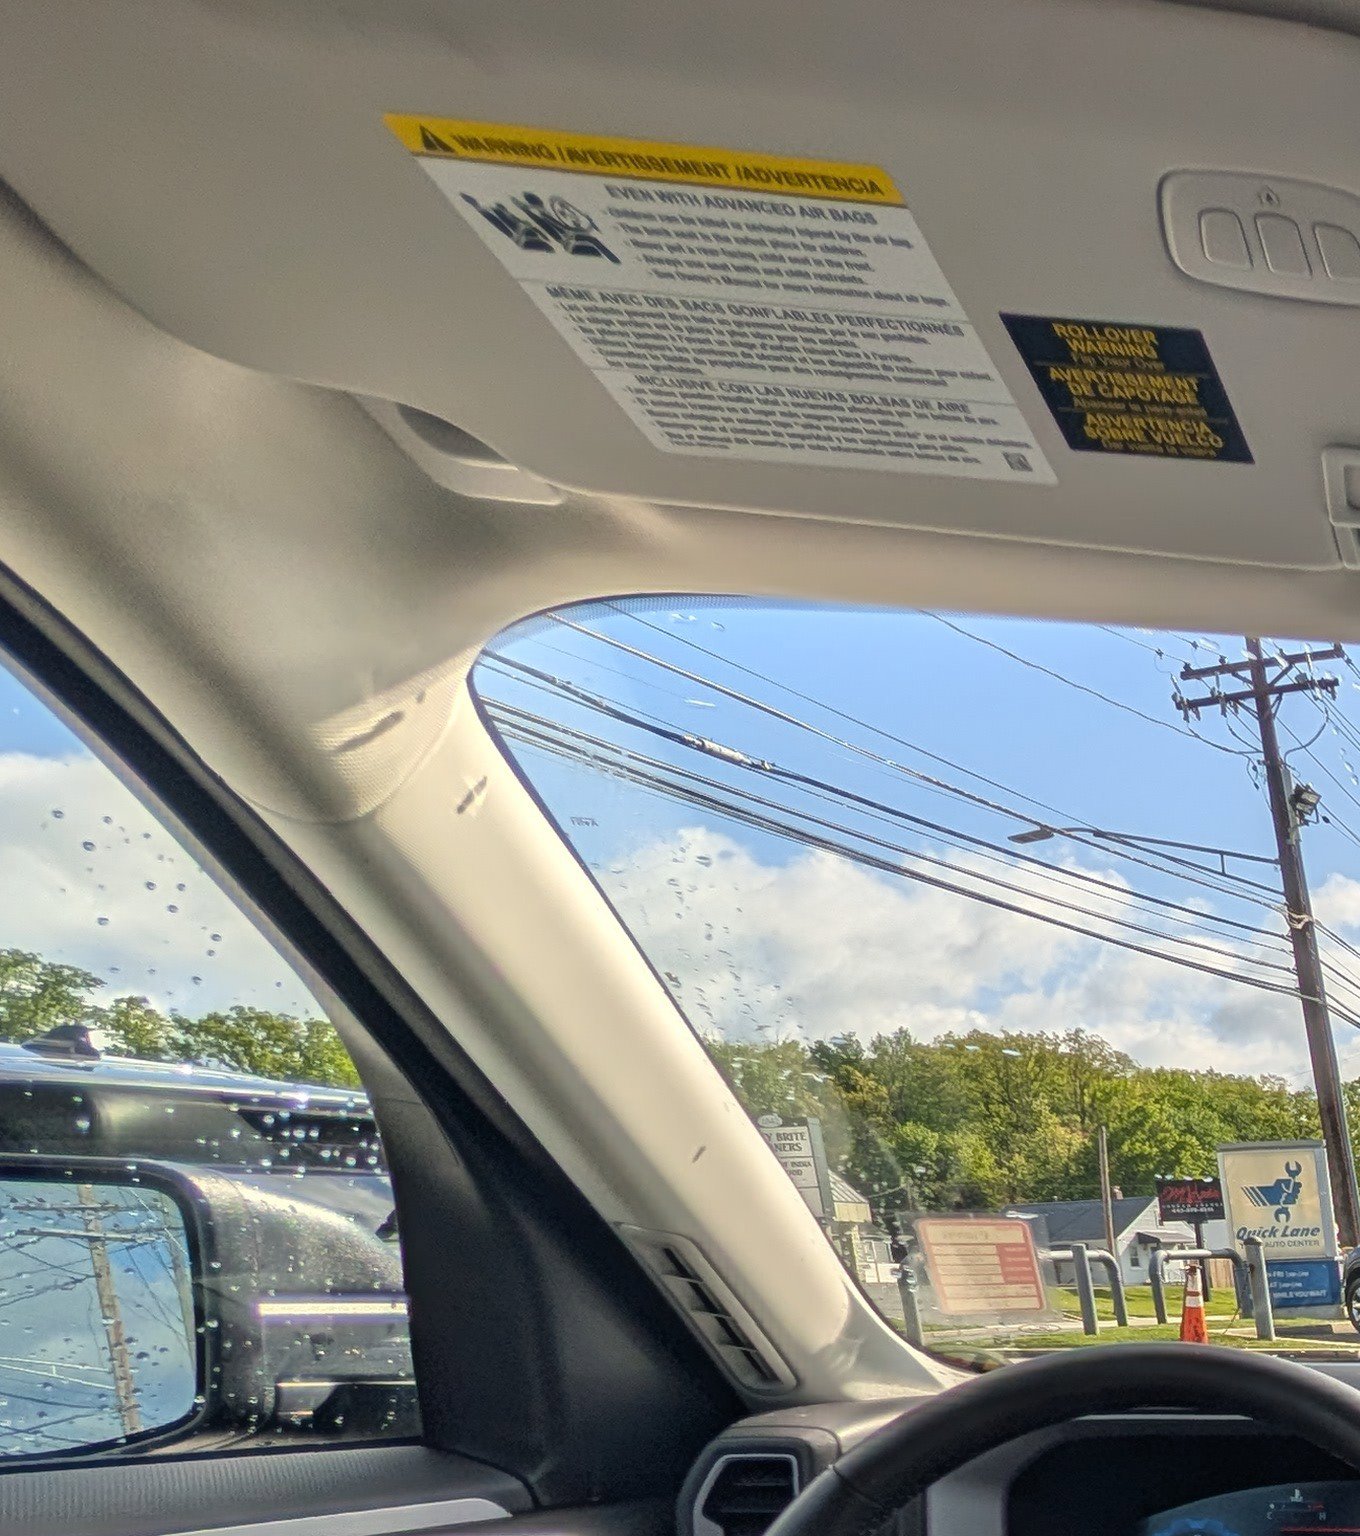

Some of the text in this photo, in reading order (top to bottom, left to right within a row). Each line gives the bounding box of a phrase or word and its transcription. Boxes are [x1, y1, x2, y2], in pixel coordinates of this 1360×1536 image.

[451, 134, 557, 161] WARNING
[604, 184, 878, 225] EVEN WITH ADVANCED AIR BAGS
[599, 292, 643, 307] AVEC
[642, 294, 680, 310] DES
[680, 299, 726, 315] SACS
[727, 303, 835, 325] GONFLABLES
[1052, 322, 1158, 345] ROLLOVER
[1065, 338, 1158, 359] WARNING
[1049, 366, 1199, 391] AVERTISSEMENT
[718, 381, 752, 394] CON
[752, 385, 786, 397] LAS
[785, 387, 848, 403] NUEVAS
[848, 393, 911, 409] BOLSAS
[1067, 380, 1199, 405] DE CAPOTAGE
[1085, 410, 1215, 435] ADVERTENCIA
[1149, 430, 1223, 449] VUELCO
[774, 1143, 802, 1152] NERS
[776, 1132, 807, 1141] BRITE
[1236, 1225, 1321, 1240] Quick Lane
[1265, 1240, 1286, 1248] AUTO
